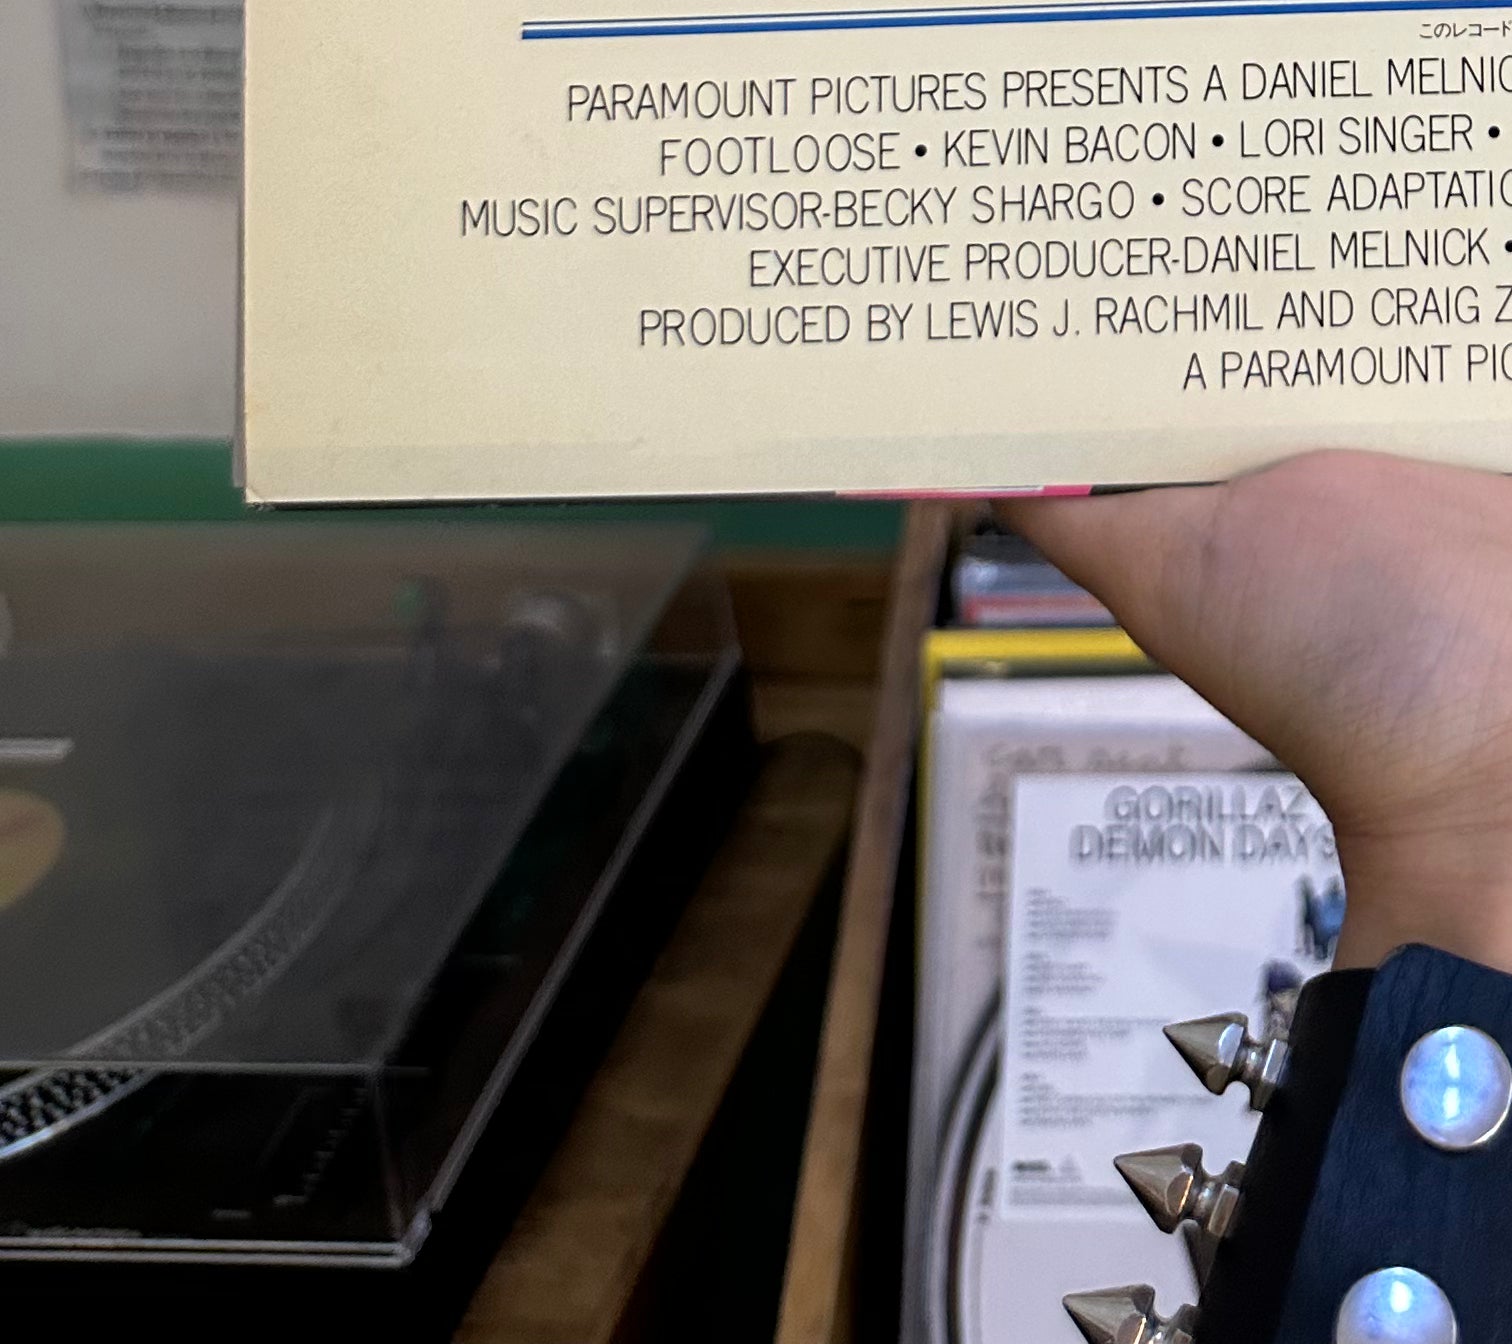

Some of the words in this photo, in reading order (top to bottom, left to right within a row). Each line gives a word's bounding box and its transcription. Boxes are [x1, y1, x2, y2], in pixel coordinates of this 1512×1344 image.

[568, 78, 797, 122] PARAMOUNT
[811, 71, 987, 115] PICTURES
[1003, 65, 1189, 109] PRESENTS
[1203, 64, 1227, 102] A
[1242, 59, 1373, 101] DANIEL
[660, 132, 901, 177] FOOTLOOSE
[944, 127, 1048, 168] KEVIN
[1065, 121, 1196, 164] BACON
[1240, 117, 1324, 159] LORI
[1338, 113, 1473, 156] SINGER
[1183, 352, 1207, 390] A
[1221, 344, 1452, 389] PARAMOUNT
